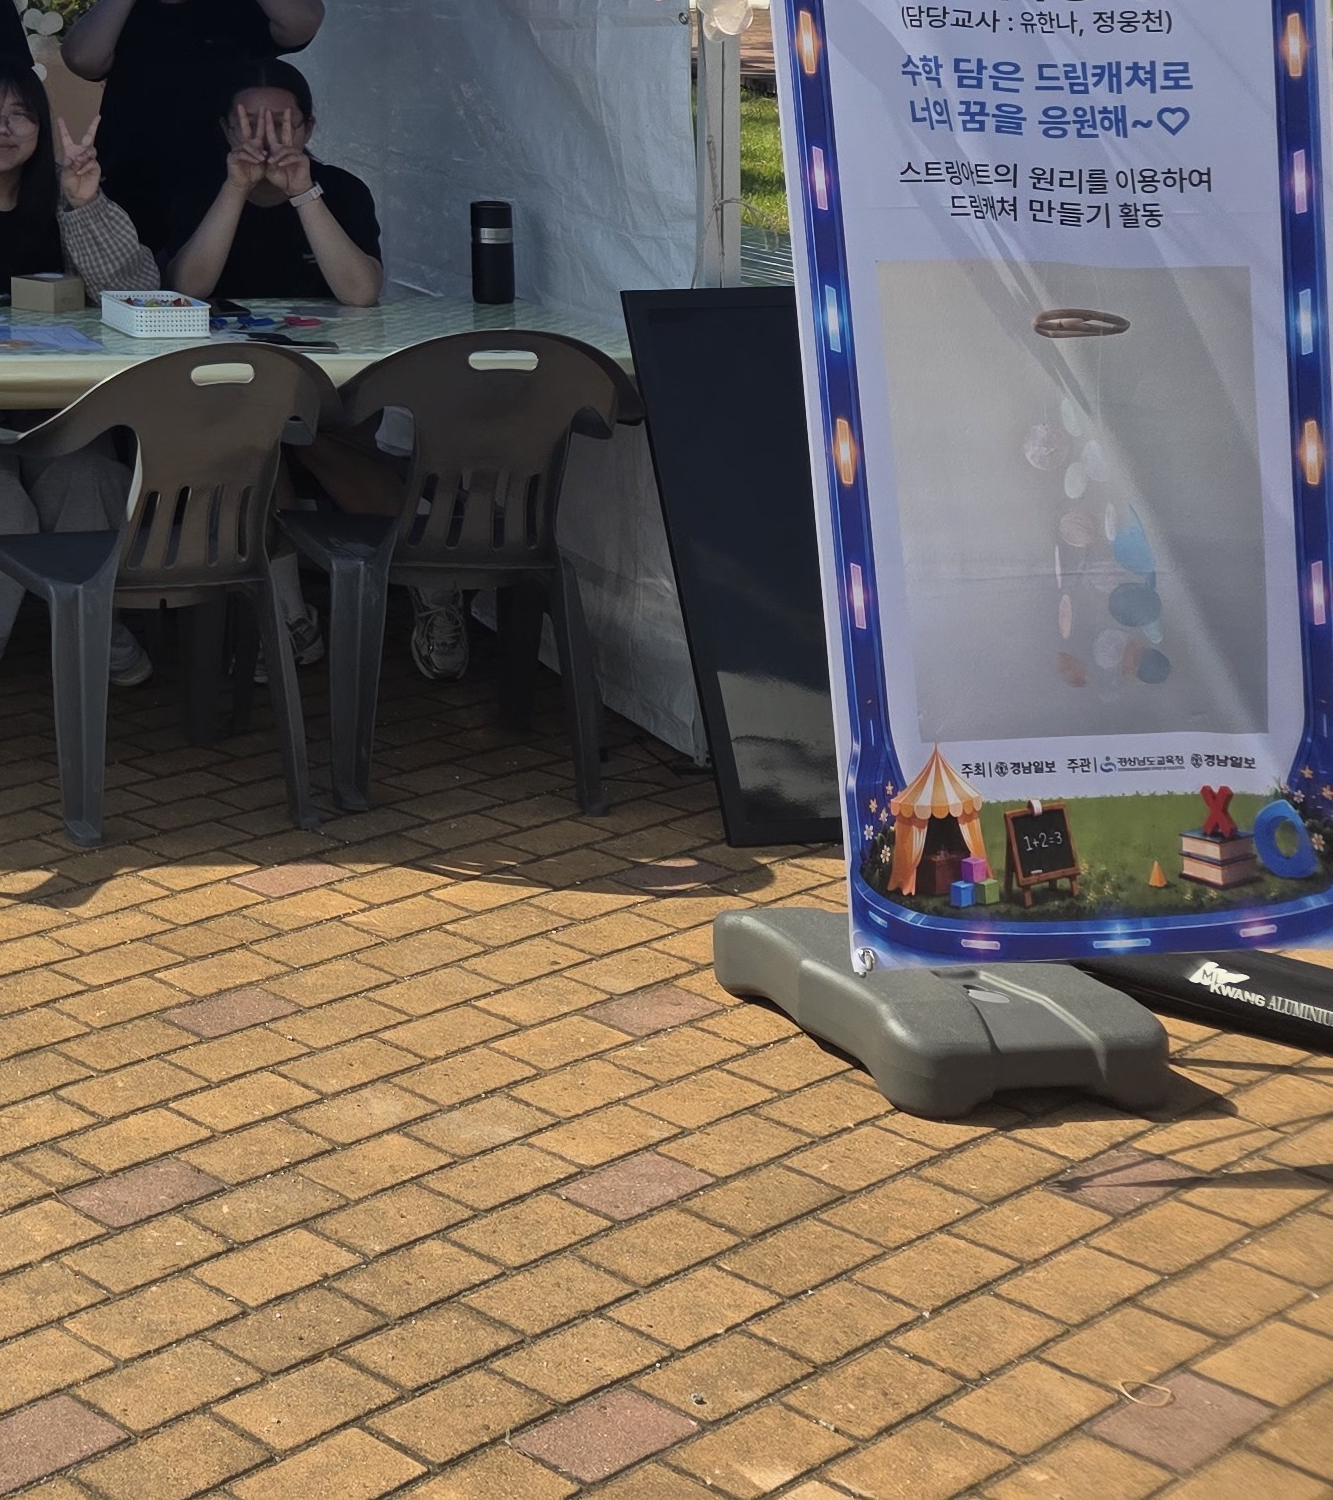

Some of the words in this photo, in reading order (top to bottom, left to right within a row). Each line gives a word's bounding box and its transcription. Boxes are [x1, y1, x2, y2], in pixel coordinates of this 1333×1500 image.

[900, 5, 1000, 33] (담당교사
[1019, 11, 1084, 37] 유한나,
[1092, 9, 1173, 35] 정웅천)
[901, 54, 943, 89] 수학
[952, 57, 1025, 94] 담은
[1034, 59, 1194, 95] 드림캐쳐로
[909, 97, 954, 133] 너의
[957, 99, 1028, 136] 꿈을
[899, 159, 1018, 190] 스트링아트의
[1028, 166, 1110, 195] 원리를
[1115, 165, 1213, 195] 이용하여
[949, 194, 1018, 222] 드림캐쳐
[1028, 199, 1111, 229] 만들기
[1118, 202, 1164, 229] 활동
[960, 761, 986, 779] 주최
[1009, 760, 1057, 775] 경남일보
[1066, 757, 1092, 774] 주관
[1203, 753, 1257, 770] 경남일보
[1023, 830, 1063, 852] 1+2=3
[1210, 983, 1266, 1007] KWANG
